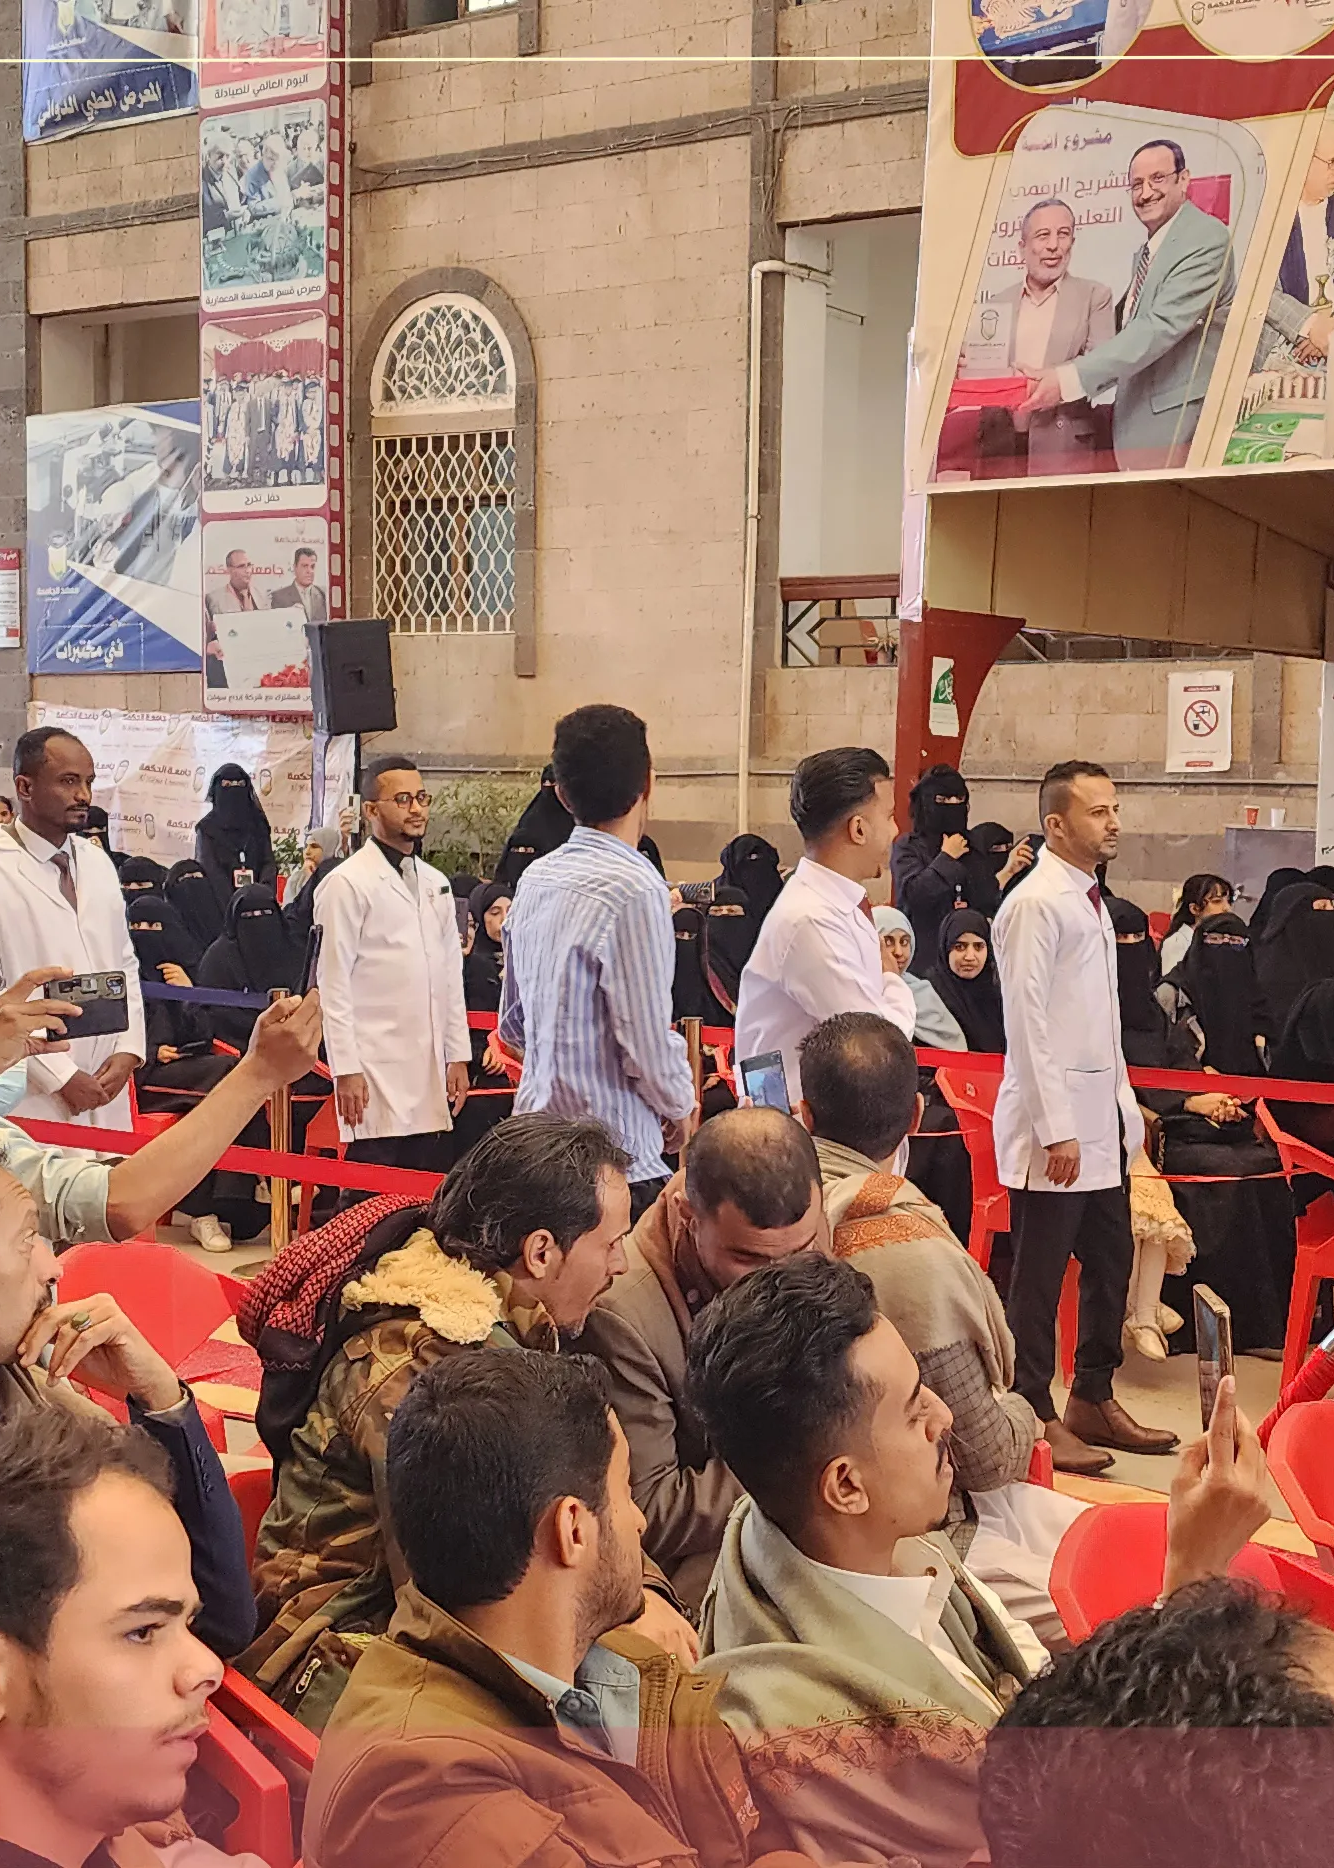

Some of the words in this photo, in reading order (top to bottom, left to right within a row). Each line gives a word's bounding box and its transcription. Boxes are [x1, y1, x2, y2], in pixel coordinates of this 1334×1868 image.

[252, 78, 283, 98] العالمي
[285, 73, 309, 89] اليوم
[120, 80, 163, 112] المعرض
[214, 83, 250, 100] للصيادلة
[81, 86, 117, 122] الطبي
[1063, 128, 1114, 152] مشروع
[241, 288, 274, 301] الهندسة
[275, 286, 295, 299] قسم
[296, 285, 321, 297] معرض
[205, 293, 239, 307] المعمارية
[244, 494, 262, 506] تخرج
[264, 493, 280, 504] حفل
[55, 640, 104, 664] مختبرات
[103, 638, 124, 668] فني
